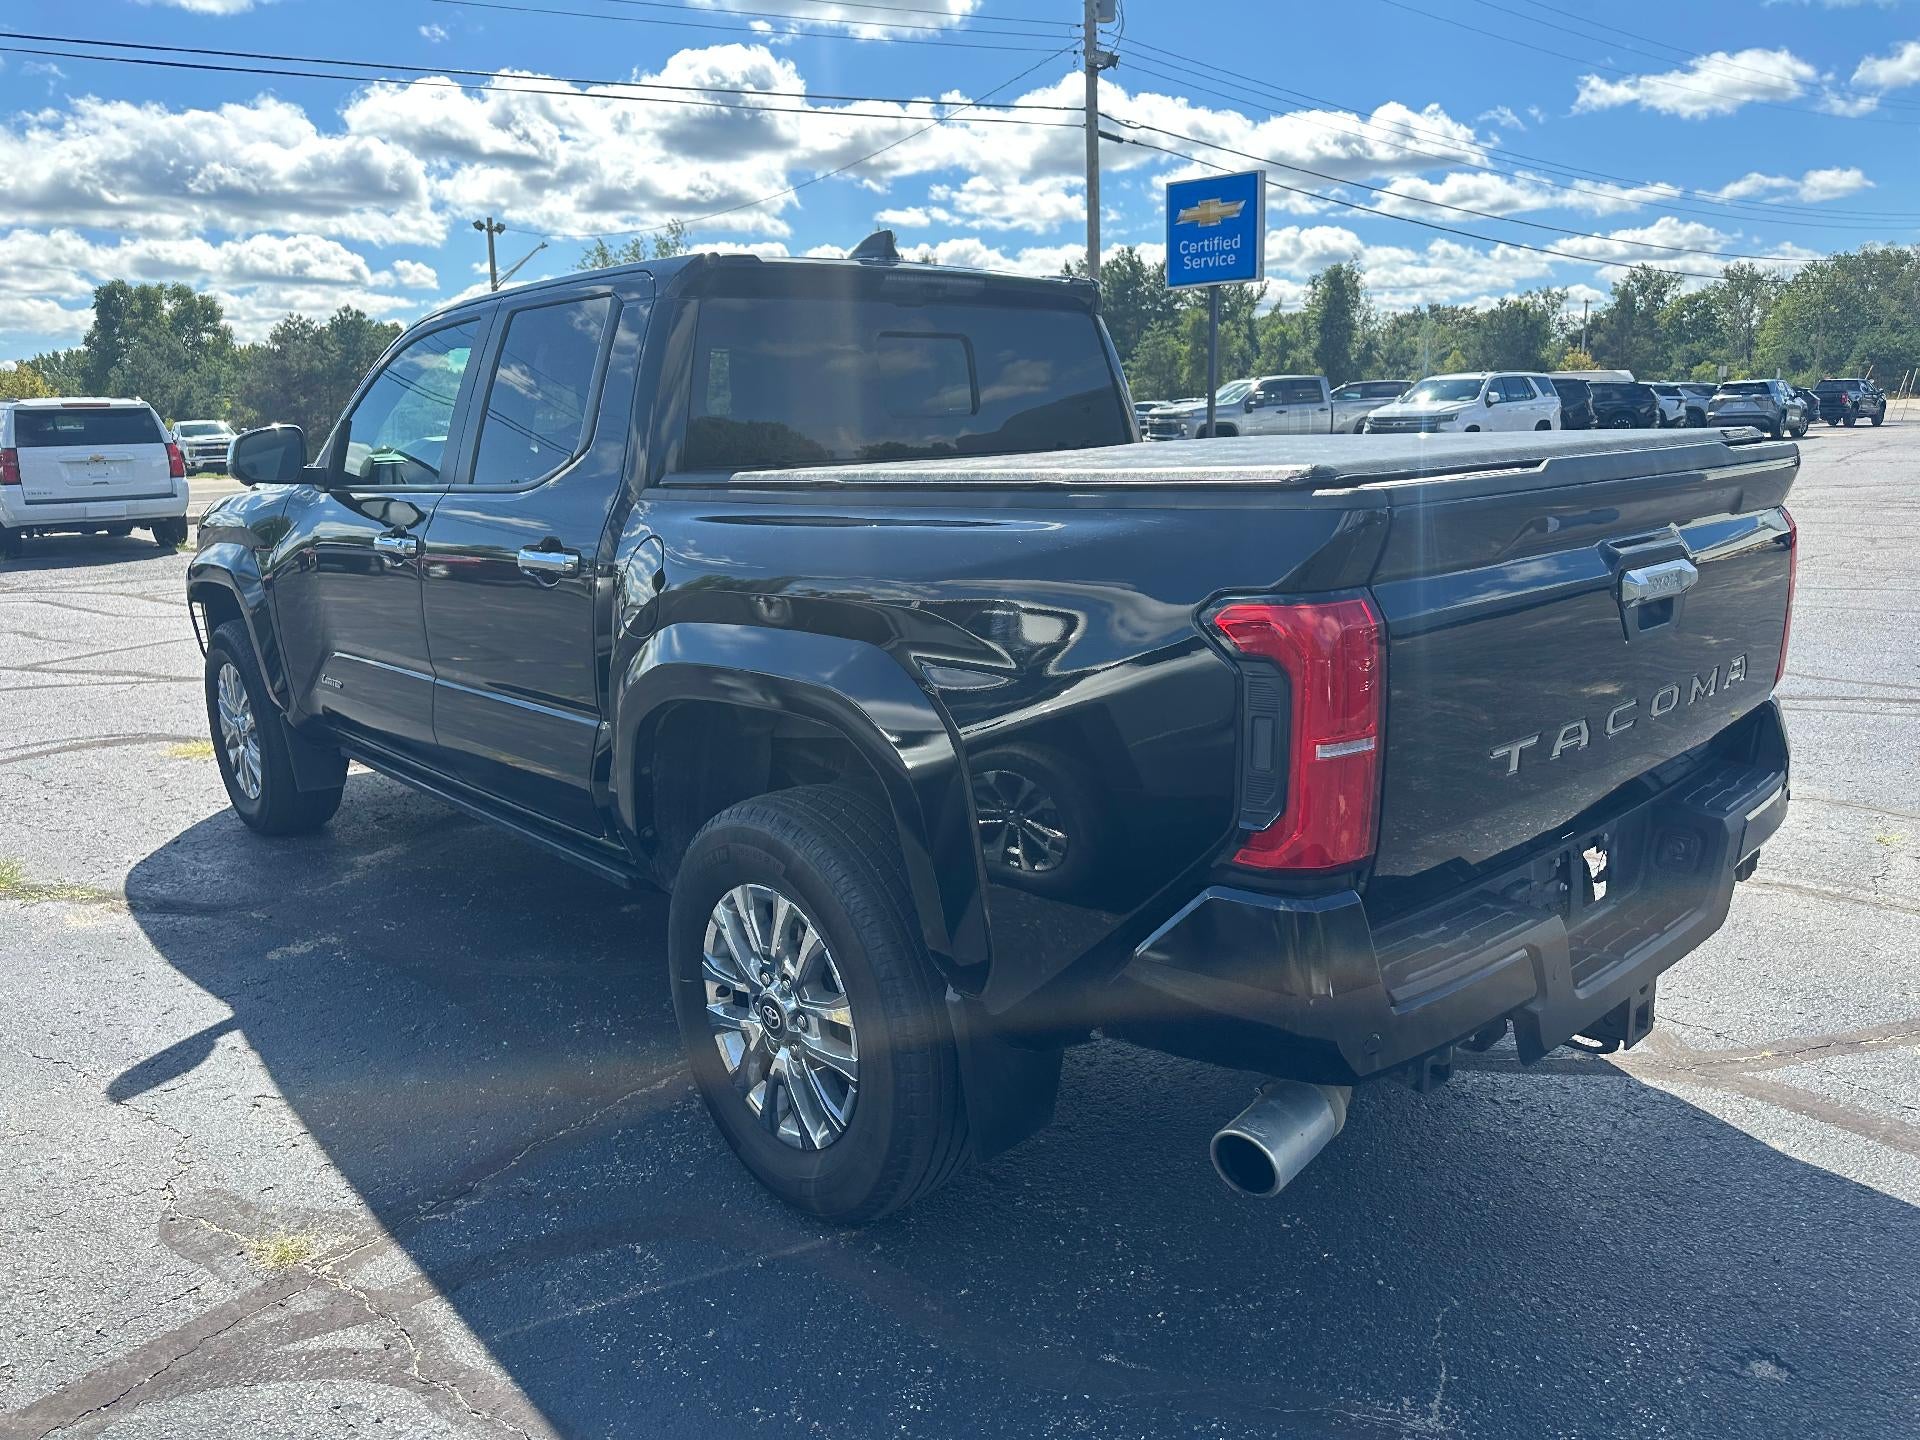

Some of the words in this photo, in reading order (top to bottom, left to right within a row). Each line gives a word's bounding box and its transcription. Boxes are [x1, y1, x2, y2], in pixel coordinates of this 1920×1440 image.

[1179, 233, 1241, 254] Certified
[1183, 252, 1236, 270] Service
[1489, 653, 1747, 776] TACOMA
